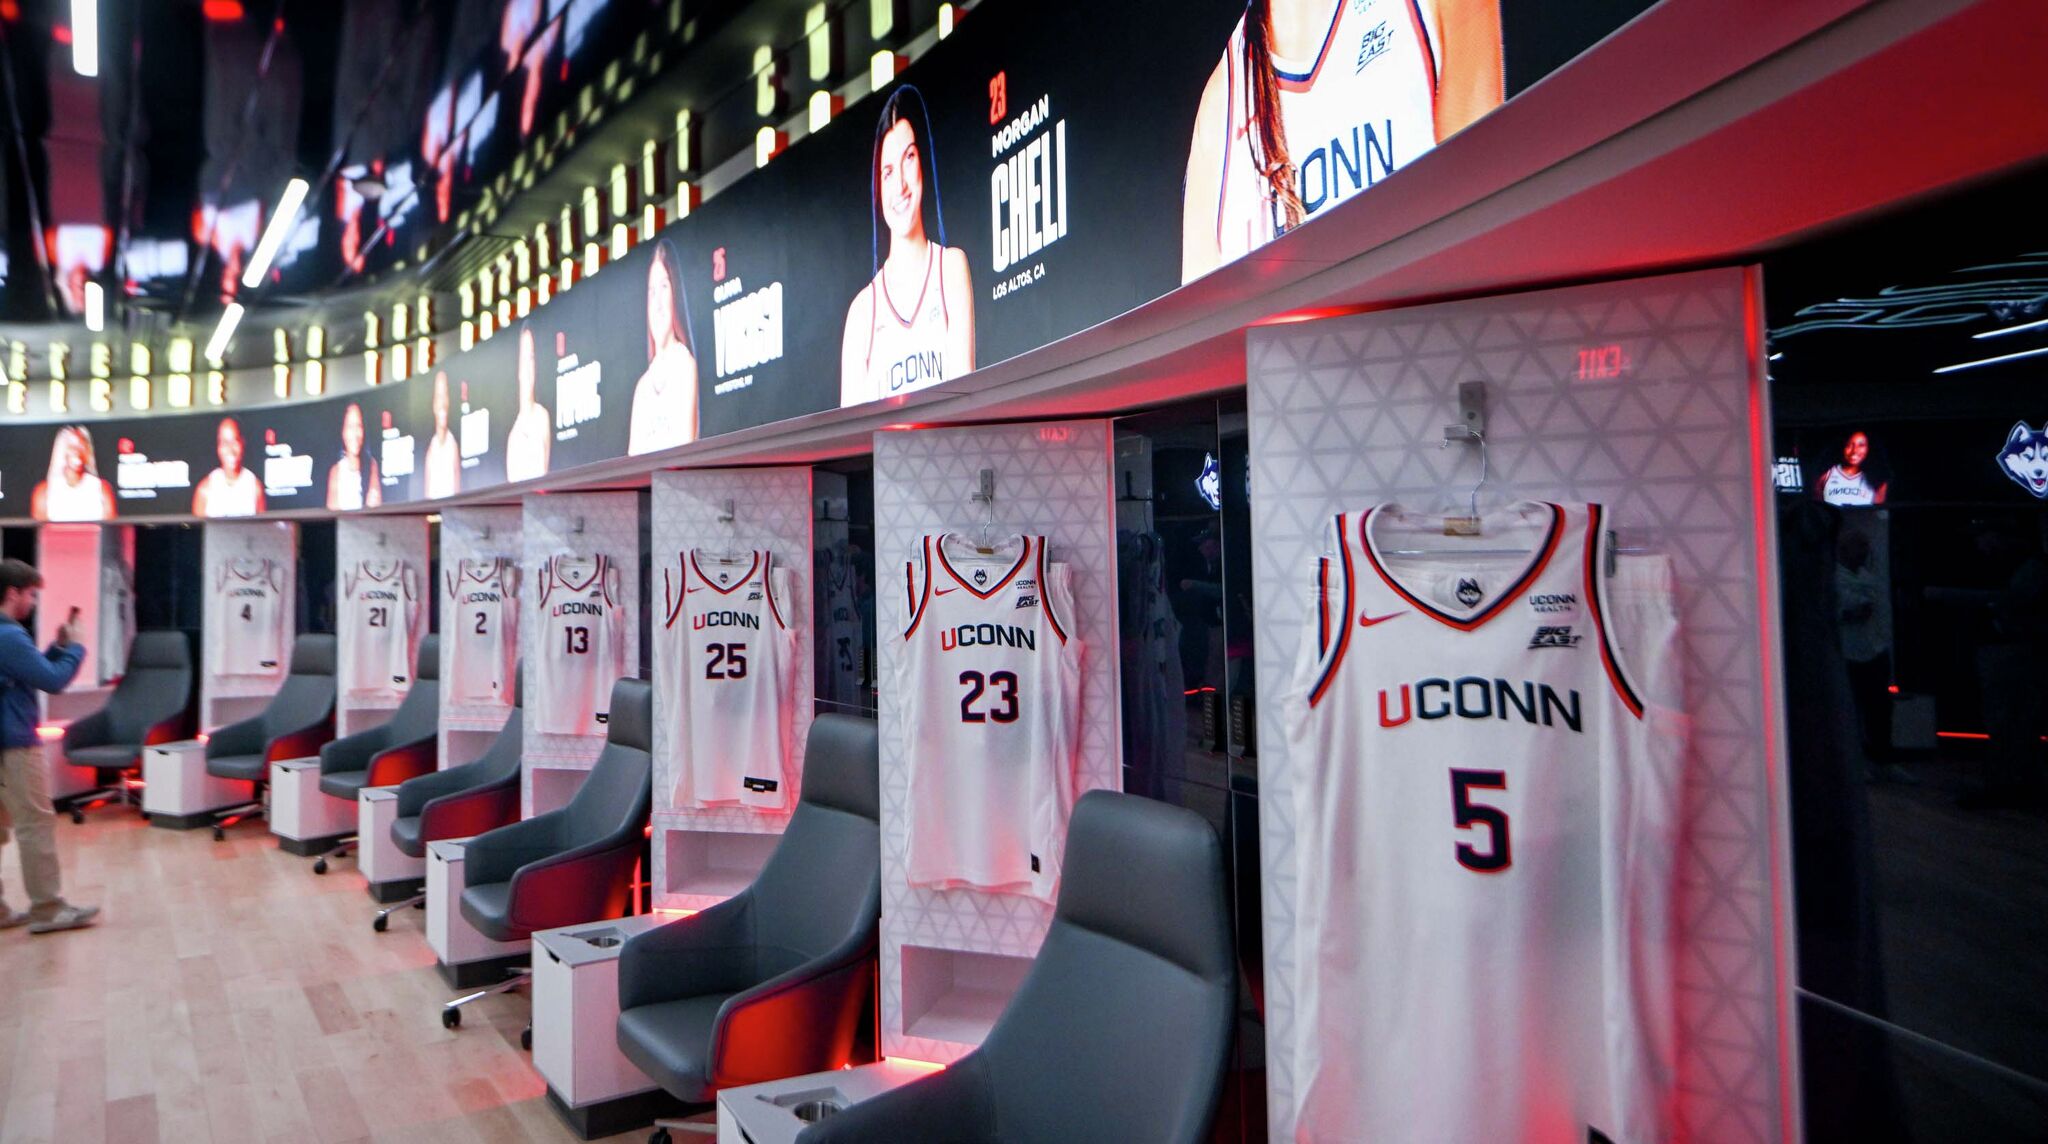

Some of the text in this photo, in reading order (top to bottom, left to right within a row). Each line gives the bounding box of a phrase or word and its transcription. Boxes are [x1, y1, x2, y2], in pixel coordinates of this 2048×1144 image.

[1357, 29, 1395, 66] EAST
[1362, 20, 1386, 49] BIG
[989, 69, 1008, 126] 23
[991, 93, 1050, 158] MORGAN
[991, 118, 1068, 273] CHELI
[992, 262, 1046, 300] LOS ALTOS, CA
[240, 603, 252, 622] 4
[462, 592, 500, 605] UCONN
[553, 602, 602, 617] UCONN
[1529, 593, 1576, 606] UCONN
[368, 607, 388, 627] 21
[475, 612, 487, 634] 2
[693, 611, 760, 631] UCONN
[565, 626, 589, 654] 13
[941, 624, 1036, 651] UCONN
[1529, 634, 1584, 645] EAST
[705, 643, 748, 680] 25
[959, 670, 1019, 724] 23
[1378, 676, 1584, 733] UCONN
[1448, 767, 1512, 873] 5
